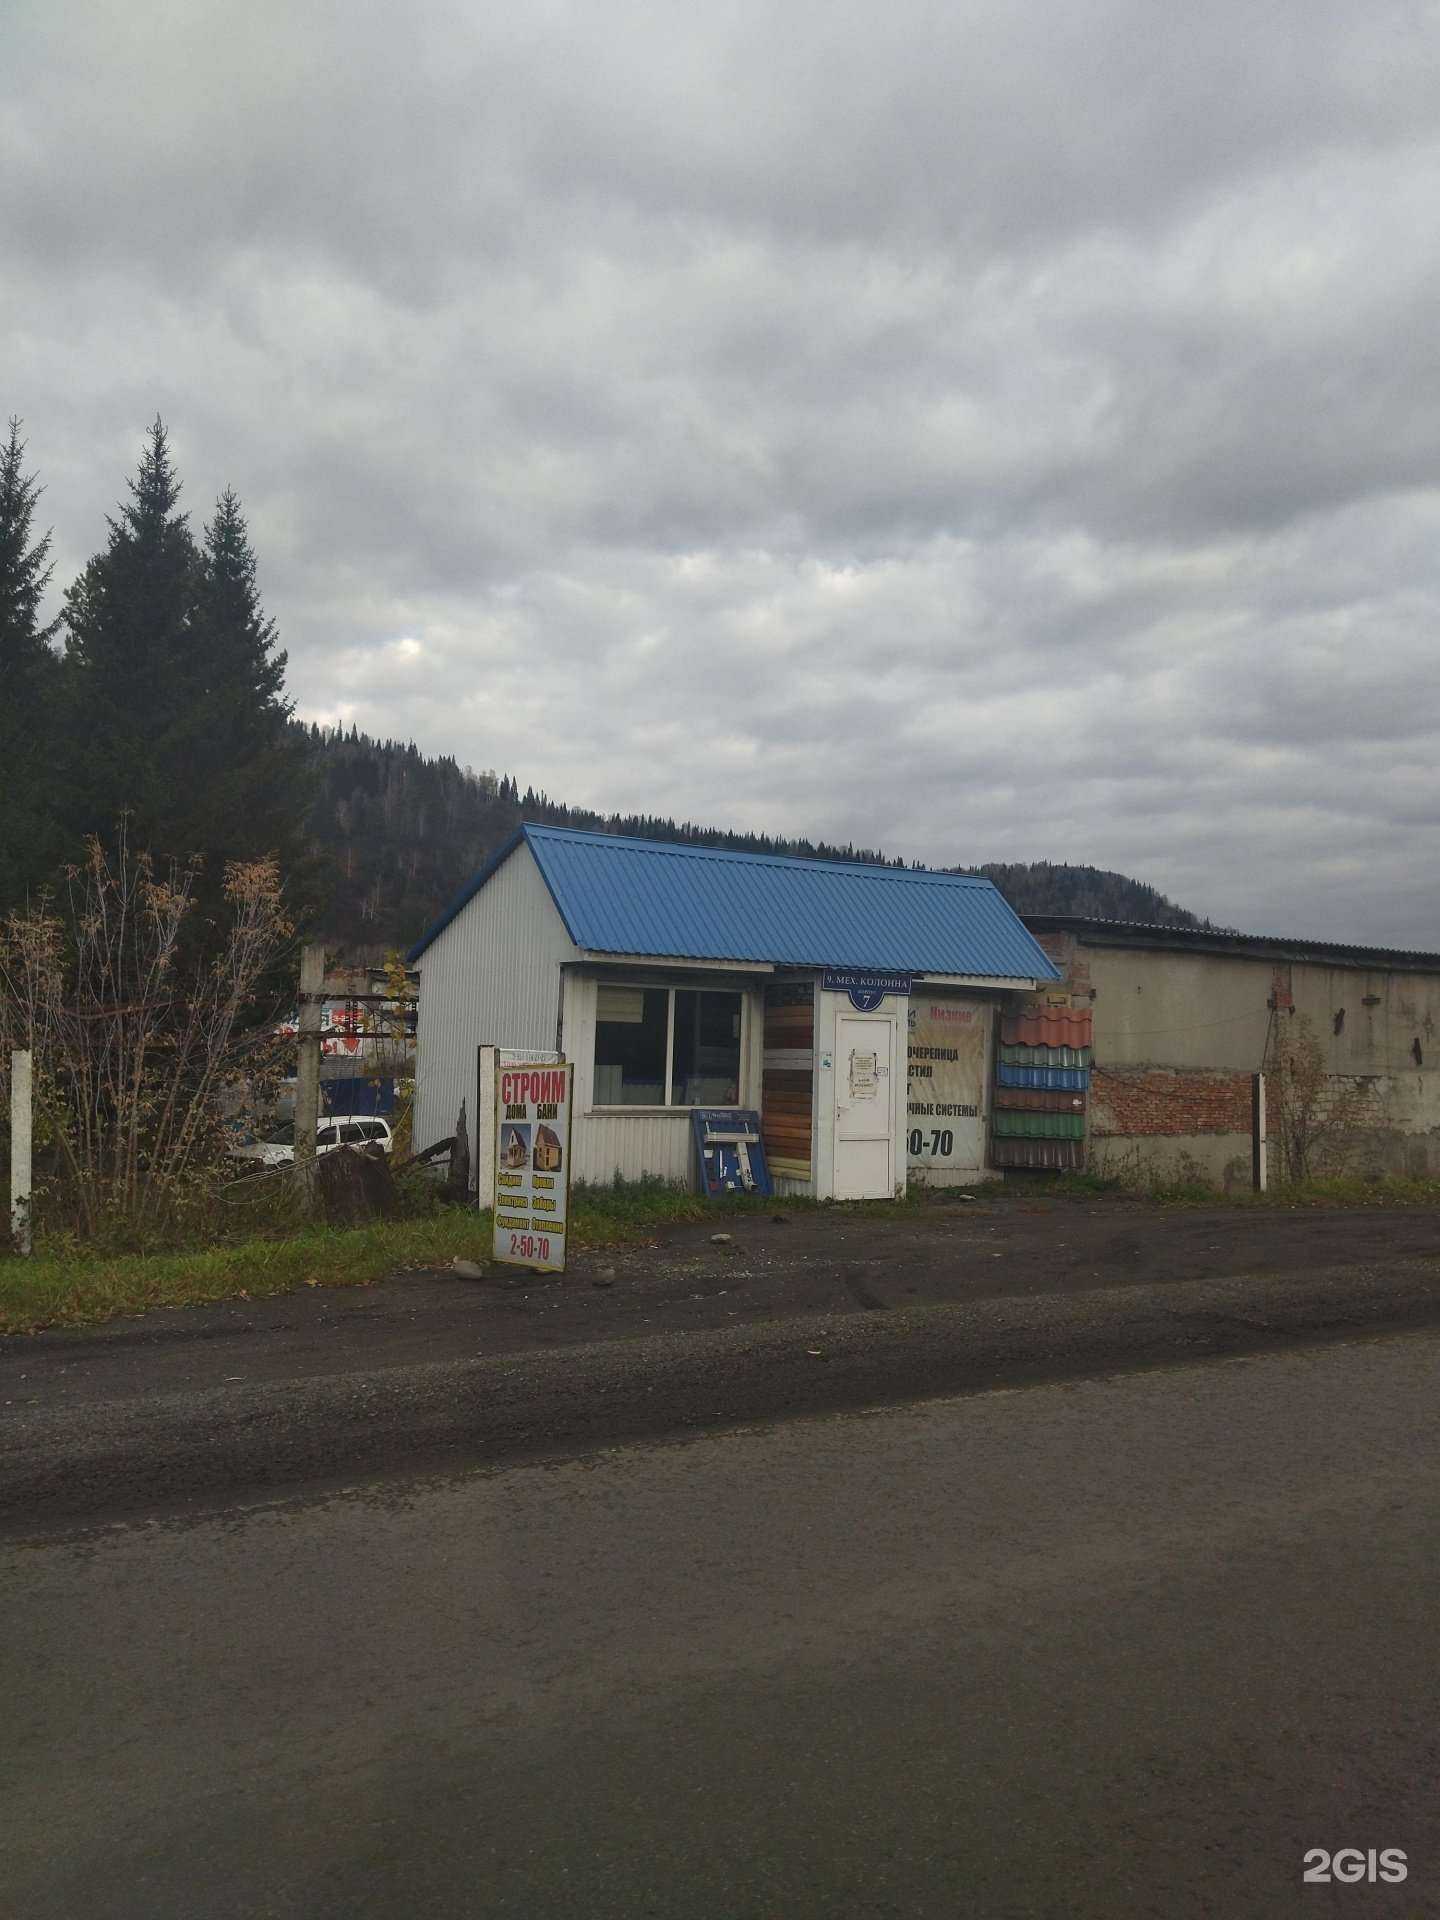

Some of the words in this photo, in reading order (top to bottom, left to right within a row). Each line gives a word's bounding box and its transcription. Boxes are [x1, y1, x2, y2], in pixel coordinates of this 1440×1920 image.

[860, 977, 908, 988] КОЛОННА
[863, 995, 871, 1008] 7
[502, 1070, 566, 1105] СТРОИМ
[505, 1103, 527, 1120] ДОМА
[536, 1103, 558, 1120] БАНИ
[936, 1103, 978, 1117] СИСТЕМЫ
[907, 1128, 954, 1157] 0-70
[510, 1233, 550, 1261] 2-50-70
